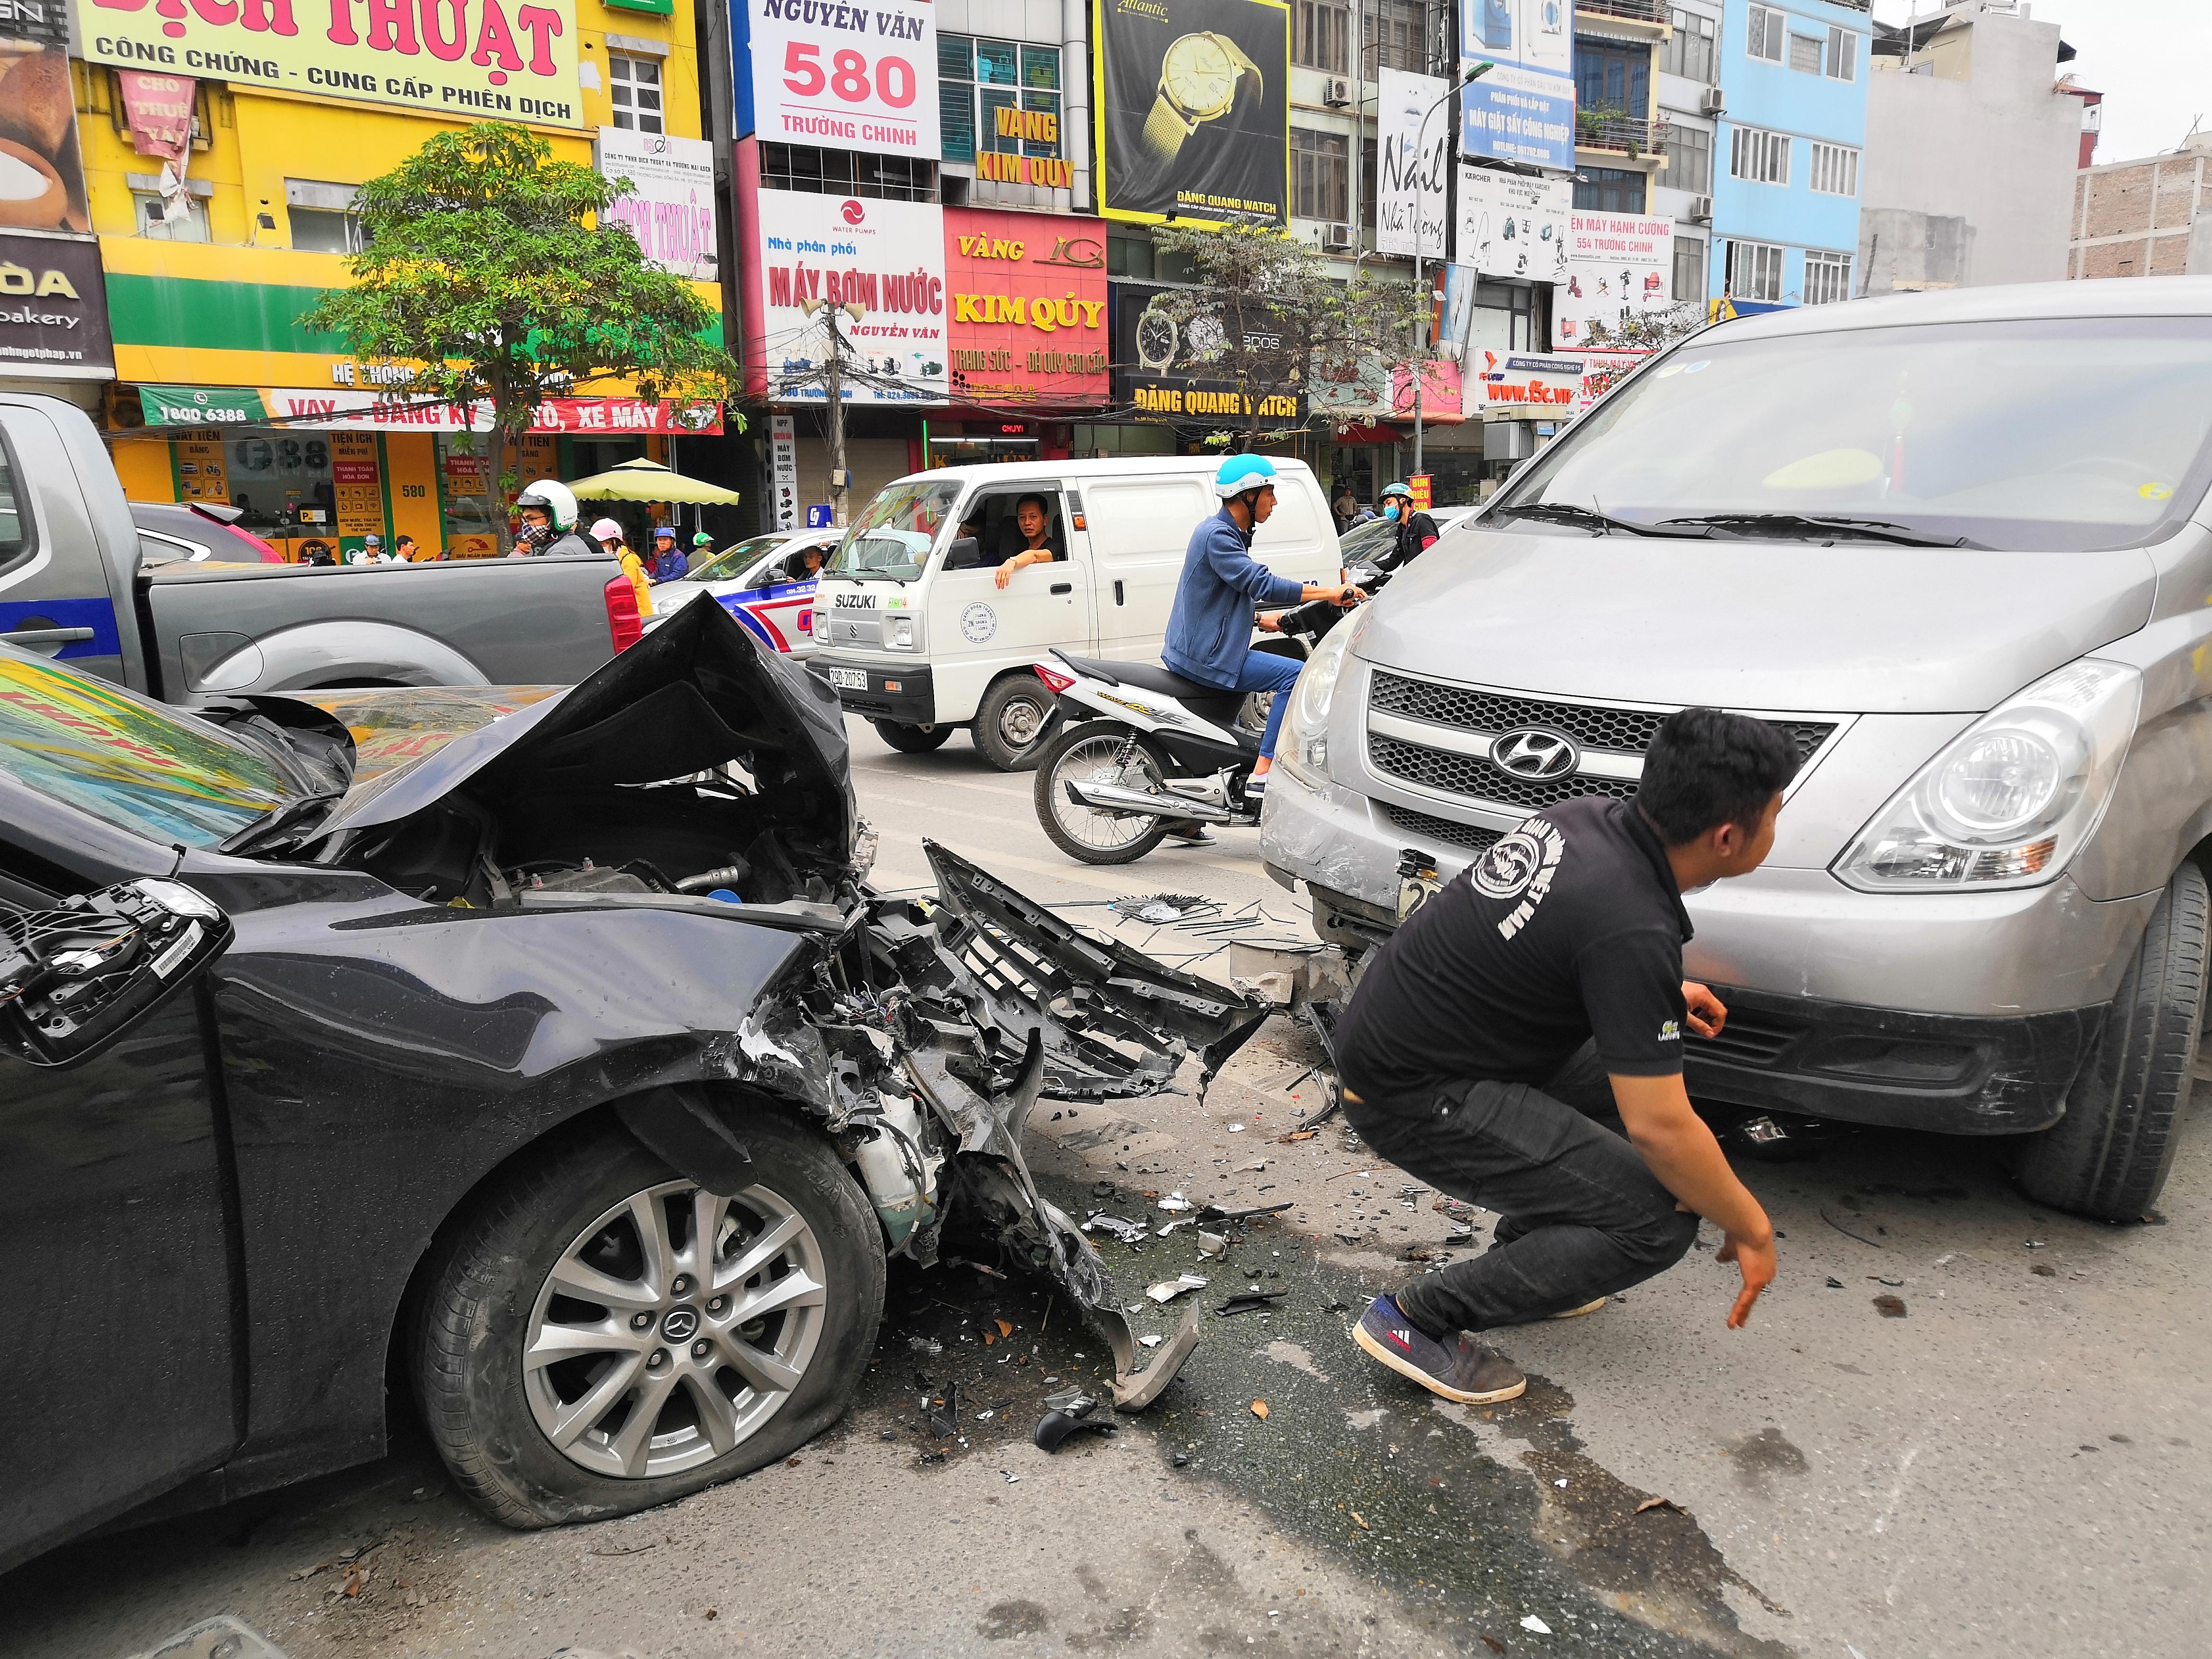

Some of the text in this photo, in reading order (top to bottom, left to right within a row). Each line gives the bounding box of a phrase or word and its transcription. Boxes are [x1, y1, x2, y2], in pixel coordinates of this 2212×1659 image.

[878, 10, 924, 41] VĂN
[96, 37, 175, 65] CÔNG
[186, 49, 278, 79] CHỨNG
[308, 67, 376, 92] CUNG
[386, 76, 433, 99] CẤP
[443, 86, 512, 111] PHIÊN
[520, 98, 571, 120] DỊCH
[137, 76, 180, 93] CHO
[782, 40, 917, 108] 580
[134, 101, 189, 118] THUÊ
[996, 101, 1057, 143] VÀNG
[781, 114, 917, 145] TRƯỜNG CHINH
[1469, 107, 1570, 145] MÁY GIẶT SẤY CÔNG NGHIỆP
[976, 150, 1022, 184] KIM
[1177, 190, 1276, 214] ĐĂNG QUANG WATCH
[1587, 216, 1607, 232] MÁY
[1610, 220, 1635, 236] HẠNH
[768, 237, 856, 256] Nhà phân phối
[959, 232, 1024, 260] VÀNG
[1577, 238, 1591, 249] 554
[1629, 241, 1653, 252] CHINH
[769, 261, 942, 315] MÁY BƠM NƯỚC
[954, 293, 1026, 325] KIM
[849, 323, 940, 340] NGUYỄN VĂN
[332, 361, 355, 386] HỆ
[951, 348, 986, 371] TRANG
[989, 344, 1011, 371] SỨC
[1026, 345, 1041, 373] ĐÁ
[1065, 352, 1085, 374] CAO
[1086, 347, 1106, 374] CẤP
[1513, 359, 1526, 367] CÔNG
[1134, 384, 1181, 412] ĐĂNG
[1185, 391, 1240, 415] QUANG
[1488, 380, 1571, 404] www.f5c.vn
[160, 406, 201, 421] 1800
[205, 409, 246, 422] 6388
[288, 398, 336, 422] VAY
[578, 407, 609, 428] XE
[612, 400, 659, 429] MÁY
[402, 485, 425, 498] 580
[835, 594, 876, 609] SUZUKI
[1497, 900, 1535, 941] NAM
